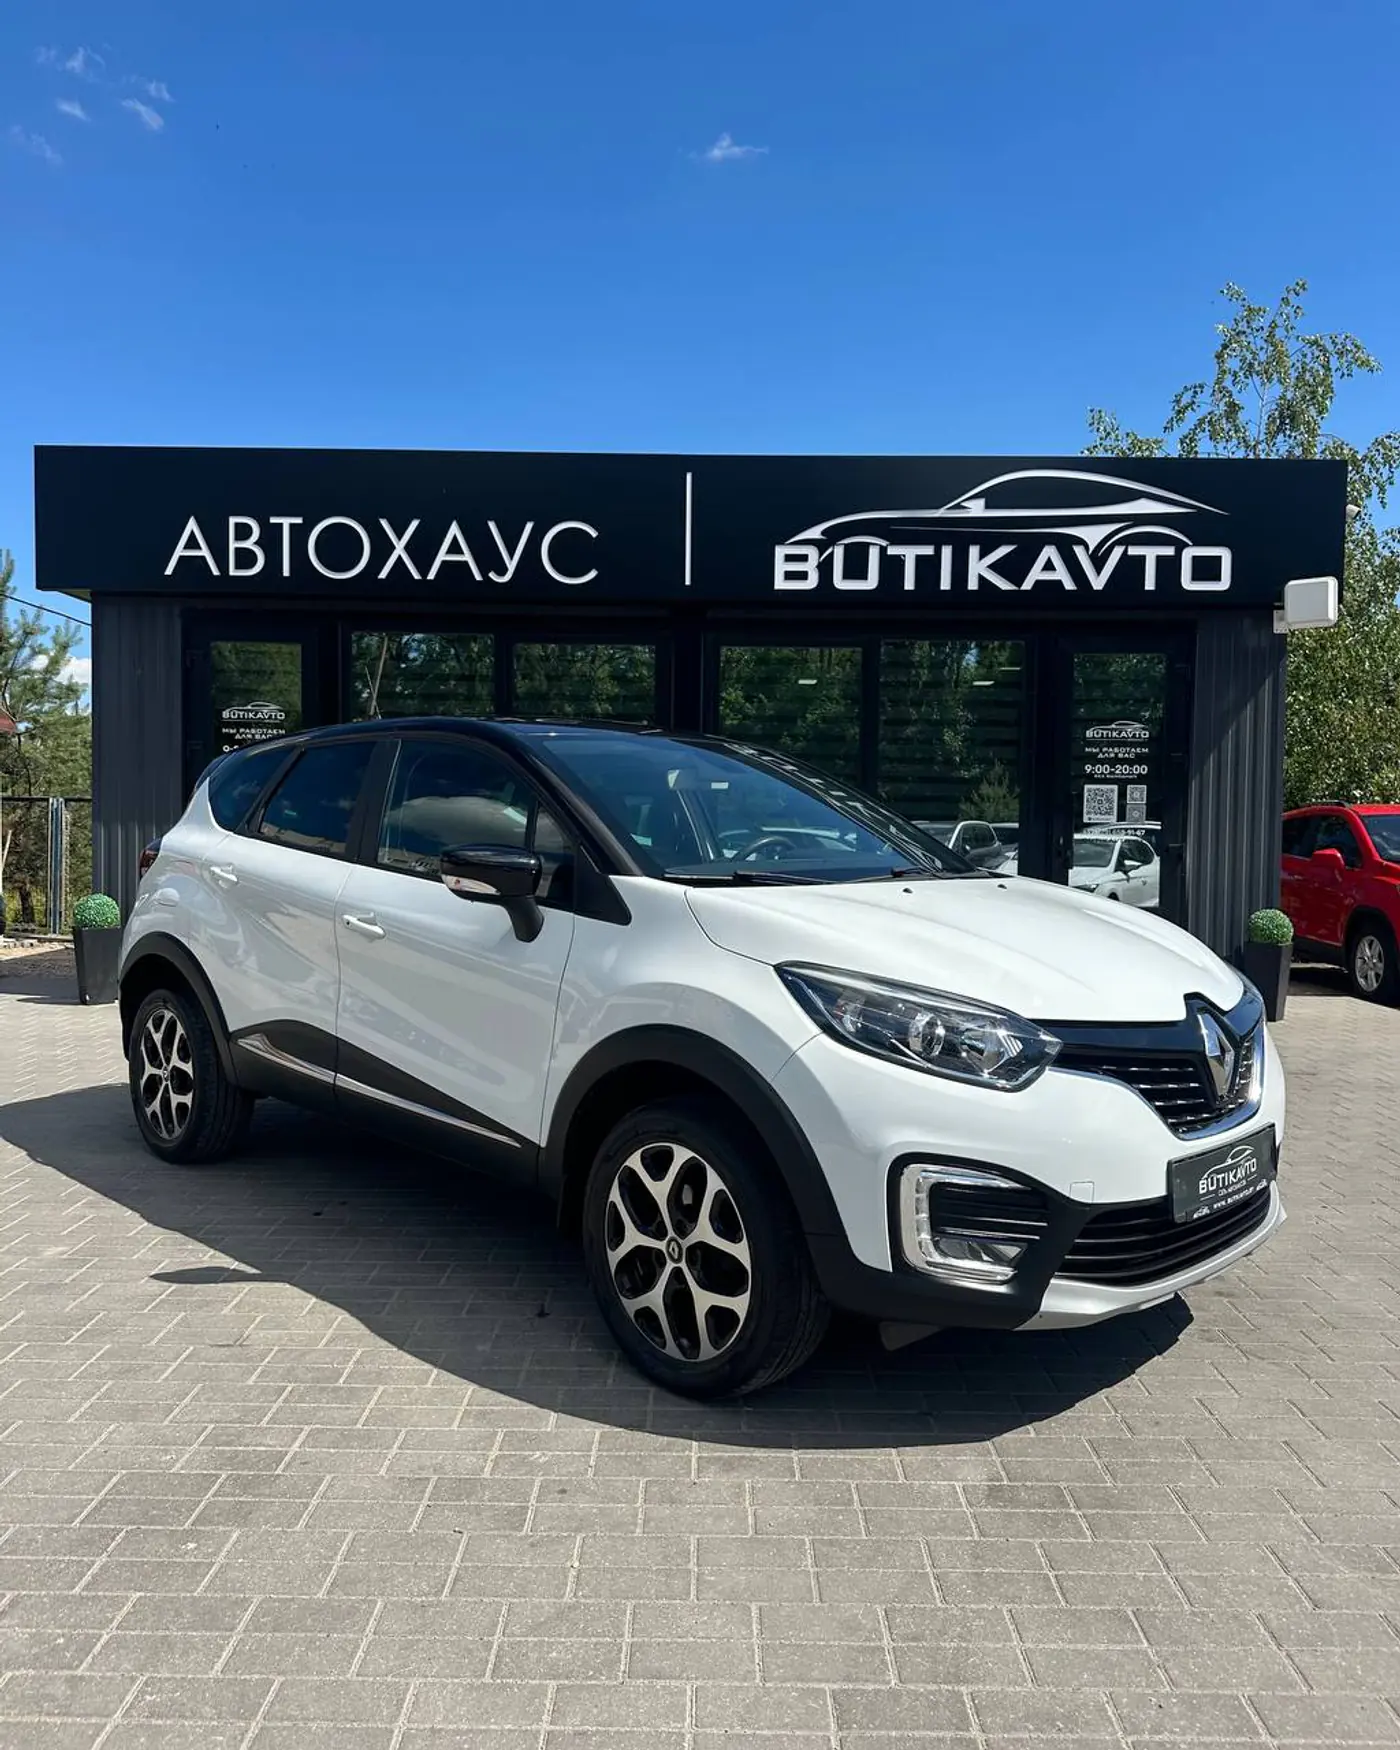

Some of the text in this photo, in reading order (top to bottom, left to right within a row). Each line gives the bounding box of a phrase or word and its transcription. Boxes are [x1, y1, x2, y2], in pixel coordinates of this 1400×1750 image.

[163, 515, 599, 585] АВТОХАУС
[773, 544, 1232, 591] BUTIKAVTO
[222, 711, 286, 719] BUTIKAVTO
[1086, 730, 1150, 738] BUTIKAVTO
[1084, 764, 1148, 775] 9:00-20:00
[1199, 1158, 1257, 1194] BUTIKAVTO
